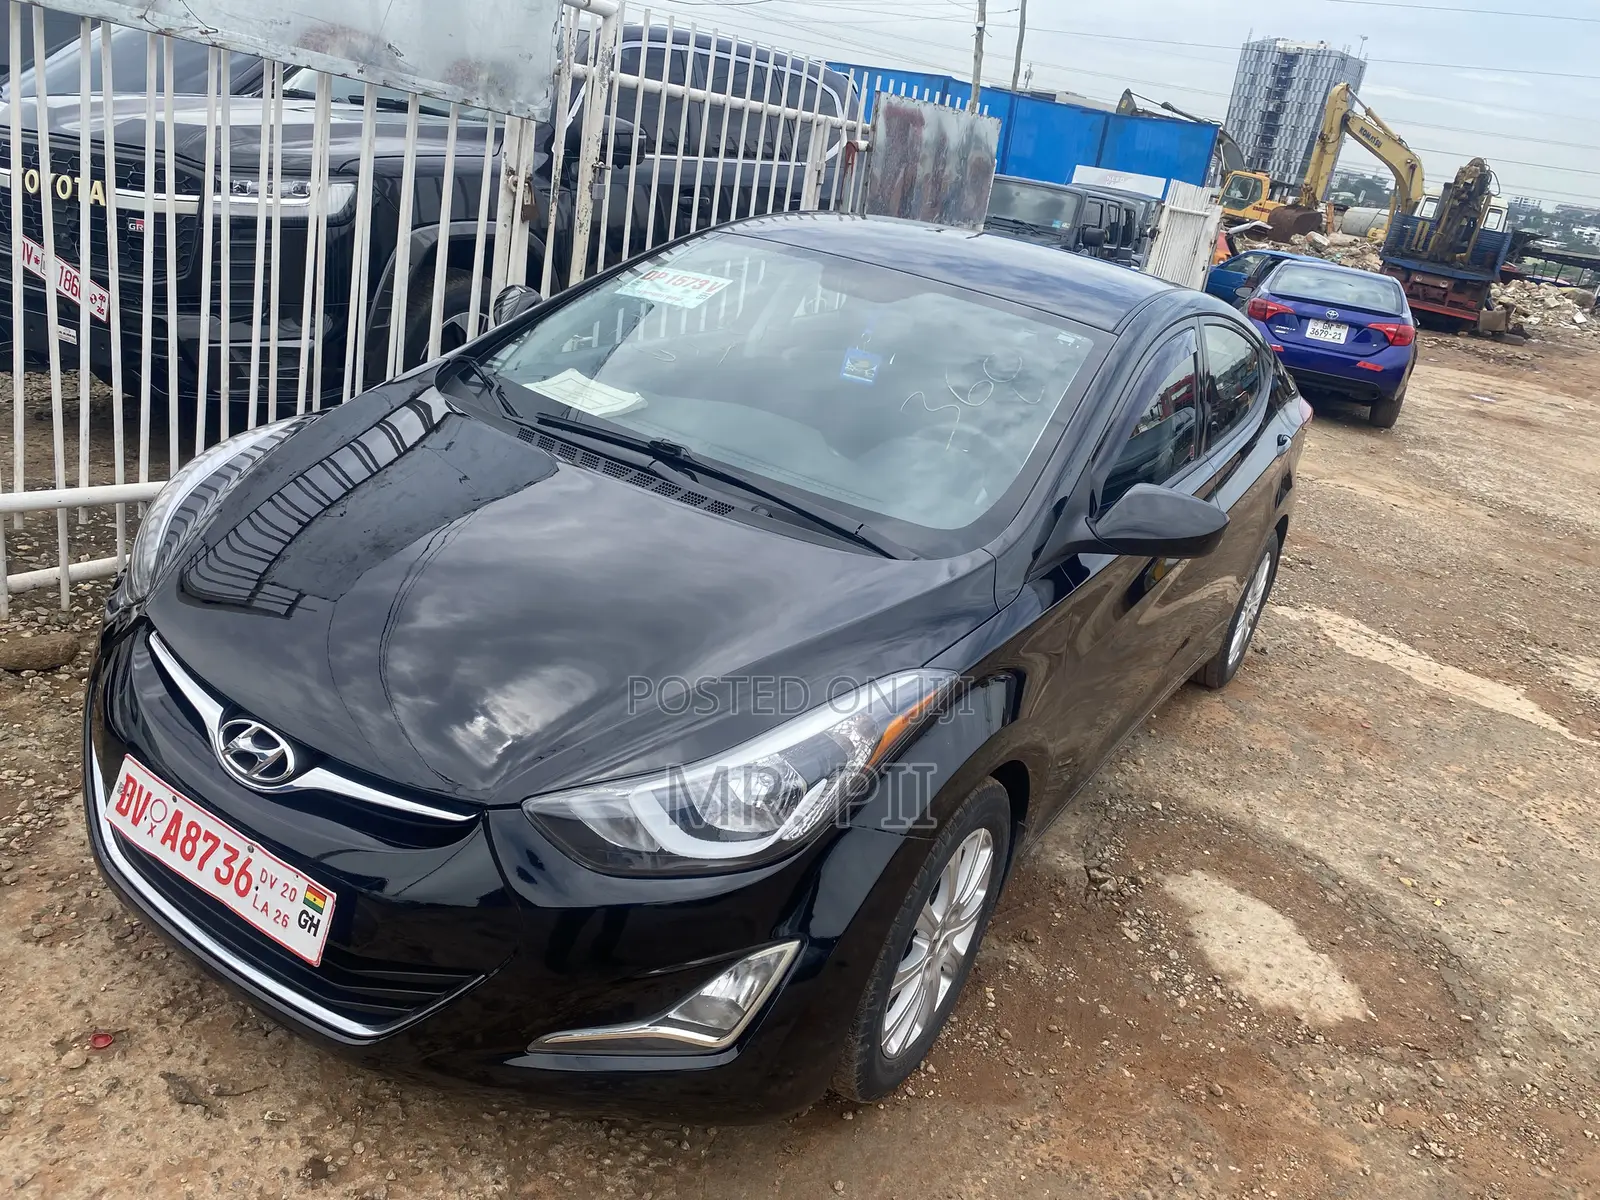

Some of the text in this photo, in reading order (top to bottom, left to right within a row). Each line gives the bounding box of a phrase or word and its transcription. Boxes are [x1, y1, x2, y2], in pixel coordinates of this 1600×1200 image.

[1359, 126, 1382, 148] KOMATSU
[58, 265, 81, 300] 186
[640, 270, 668, 281] DP
[705, 283, 724, 293] V
[1309, 328, 1342, 341] 3679-21
[115, 772, 253, 898] DV A8736
[260, 867, 297, 902] DV 20
[252, 894, 290, 928] LA 26
[298, 909, 321, 937] GH
